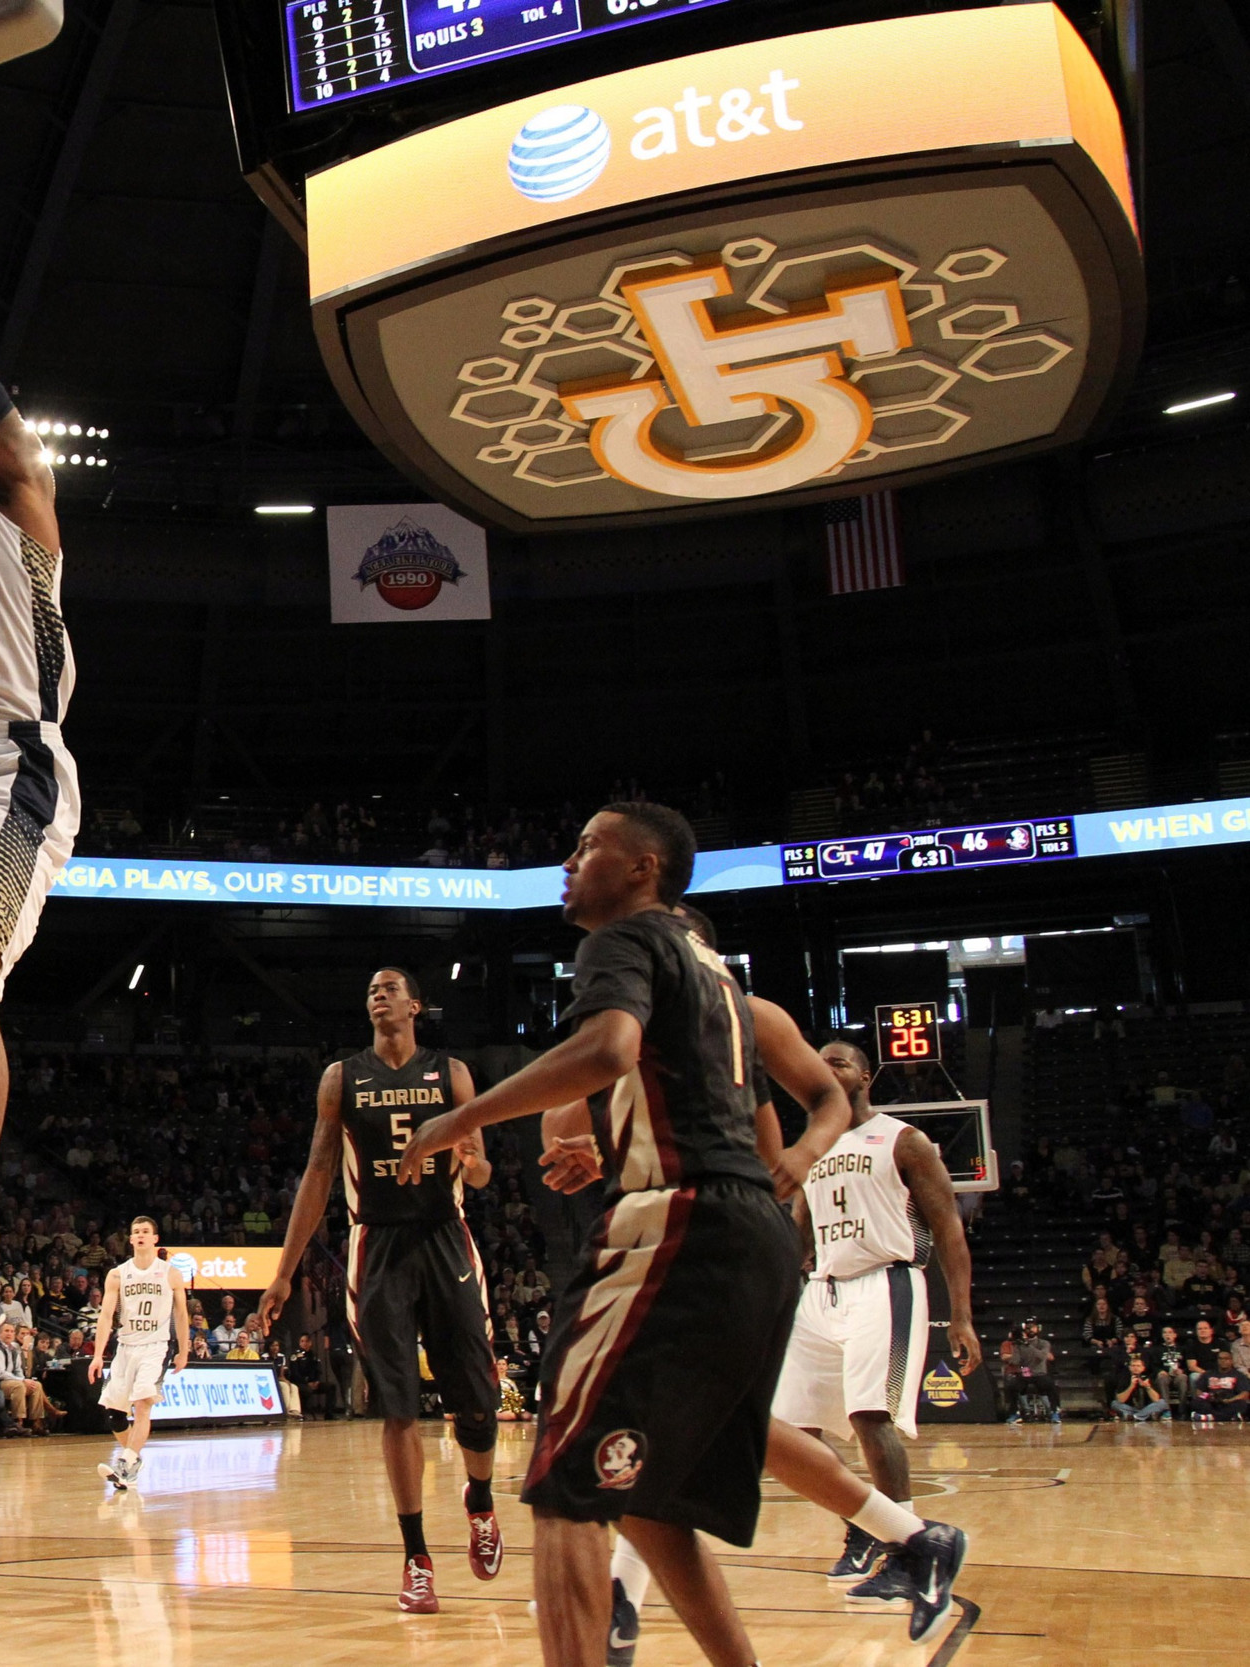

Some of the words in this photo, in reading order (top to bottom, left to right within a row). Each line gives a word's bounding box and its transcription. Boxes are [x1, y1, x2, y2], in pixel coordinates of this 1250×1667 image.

[303, 1, 327, 18] PLR
[341, 7, 353, 23] 2
[521, 6, 548, 23] TOL
[312, 15, 323, 31] 0
[344, 25, 352, 39] 1
[375, 16, 386, 32] 2
[415, 22, 468, 51] FOULS
[470, 17, 485, 37] 3
[314, 33, 325, 48] 2
[346, 42, 353, 56] 1
[373, 32, 392, 49] 15
[315, 50, 326, 66] 3
[346, 58, 357, 74] 2
[375, 49, 393, 66] 12
[317, 67, 327, 82] 4
[349, 76, 357, 91] 1
[379, 67, 390, 83] 4
[315, 82, 334, 100] 10
[629, 68, 804, 161] at&t
[388, 572, 428, 585] 1990
[1035, 824, 1056, 837] FLS
[1058, 822, 1069, 835] 5
[1109, 812, 1214, 843] WHEN
[1221, 809, 1250, 832] G
[863, 841, 886, 862] 47
[962, 831, 988, 852] 46
[784, 848, 803, 862] FLS
[911, 849, 948, 868] 6:31
[124, 868, 217, 896] PLAYS,
[224, 871, 283, 894] OUR
[291, 873, 431, 898] STUDENTS
[438, 877, 501, 899] WIN.
[892, 1010, 932, 1028] 6:31
[891, 1027, 929, 1057] 26
[355, 1087, 444, 1109] FLORIDA
[390, 1113, 412, 1150] 5
[810, 1153, 873, 1184] GEORGIA
[833, 1186, 847, 1213] 4
[818, 1218, 865, 1245] TECH
[200, 1256, 247, 1277] at&t
[124, 1283, 162, 1297] GEORGIA
[138, 1301, 152, 1316] 10
[129, 1319, 158, 1332] TECH
[926, 1378, 959, 1388] Superior
[180, 1376, 200, 1407] for
[202, 1383, 230, 1412] your
[232, 1382, 255, 1405] car.
